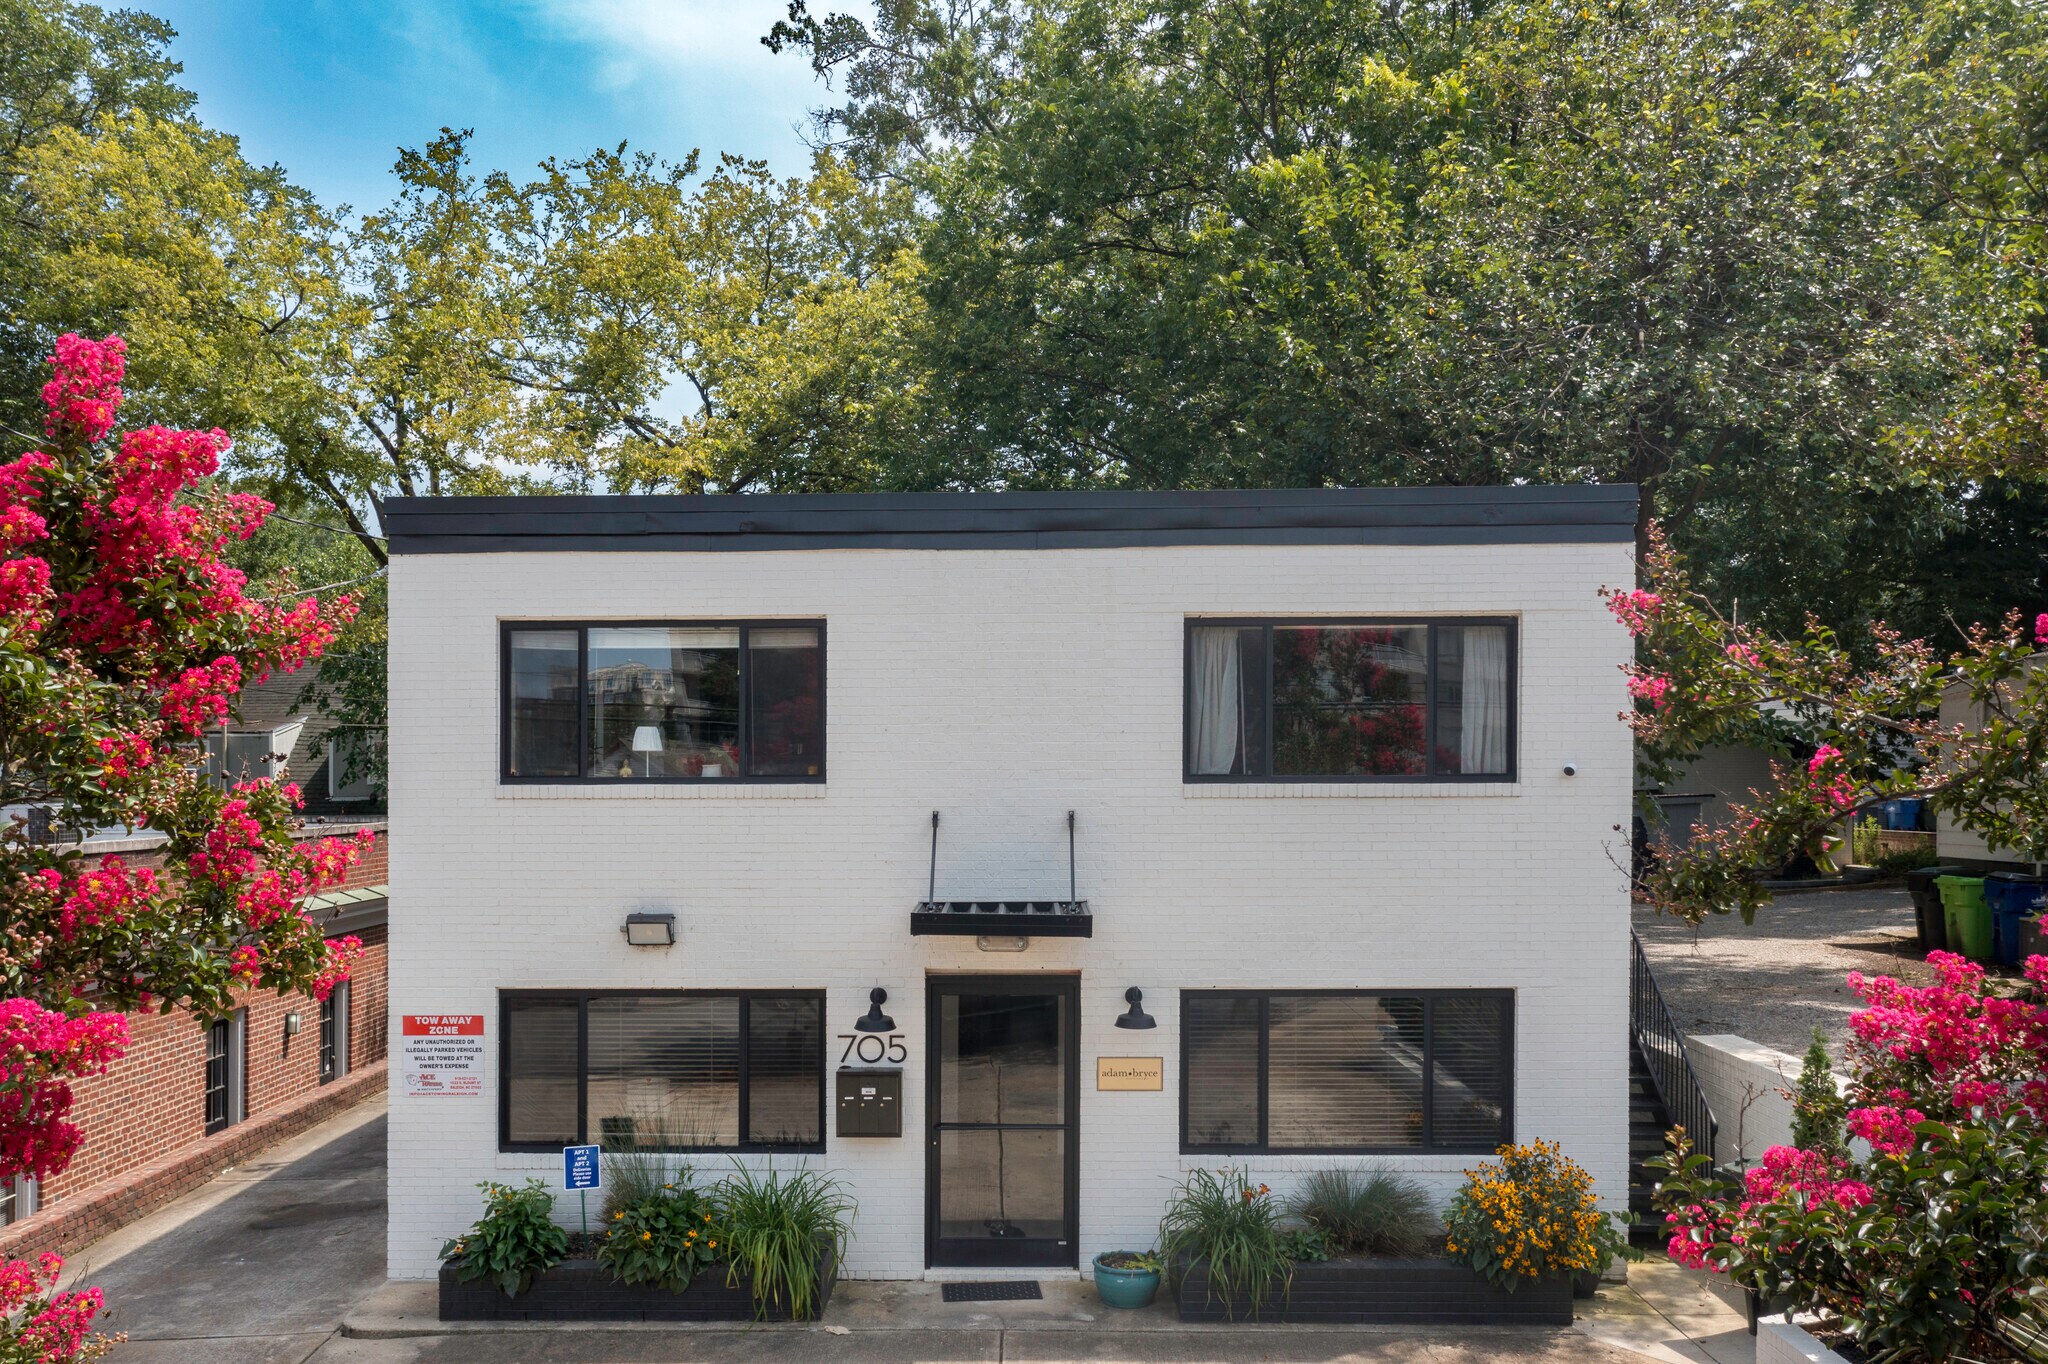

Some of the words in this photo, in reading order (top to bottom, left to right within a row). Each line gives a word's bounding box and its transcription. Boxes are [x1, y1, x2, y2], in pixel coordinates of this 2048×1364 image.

[415, 1016, 439, 1025] TOW
[441, 1016, 472, 1025] AWAY
[429, 1026, 459, 1034] ZONE
[837, 1035, 907, 1063] 705
